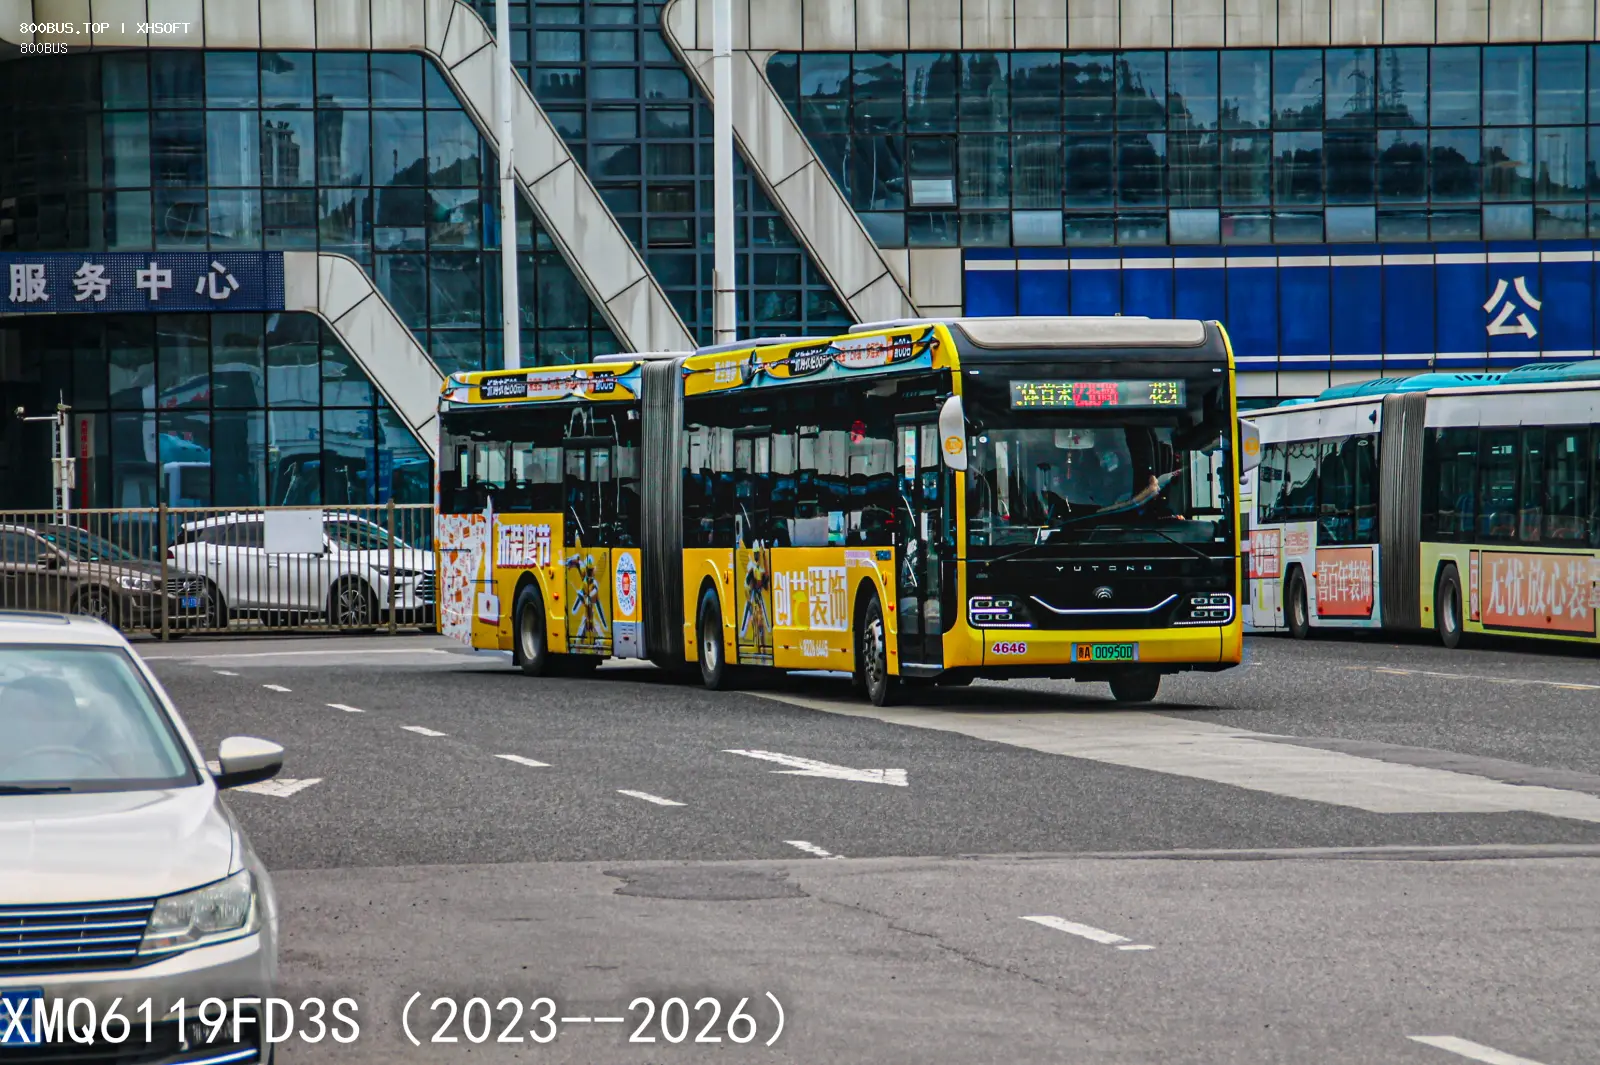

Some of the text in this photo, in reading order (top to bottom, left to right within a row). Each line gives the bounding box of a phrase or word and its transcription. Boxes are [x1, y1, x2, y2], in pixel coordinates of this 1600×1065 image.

[9, 260, 240, 302] 服务中心
[1482, 275, 1542, 340] 公
[773, 568, 848, 631] 创艺装饰
[1317, 559, 1371, 602] 喜百年装饰
[992, 642, 1027, 654] 4646
